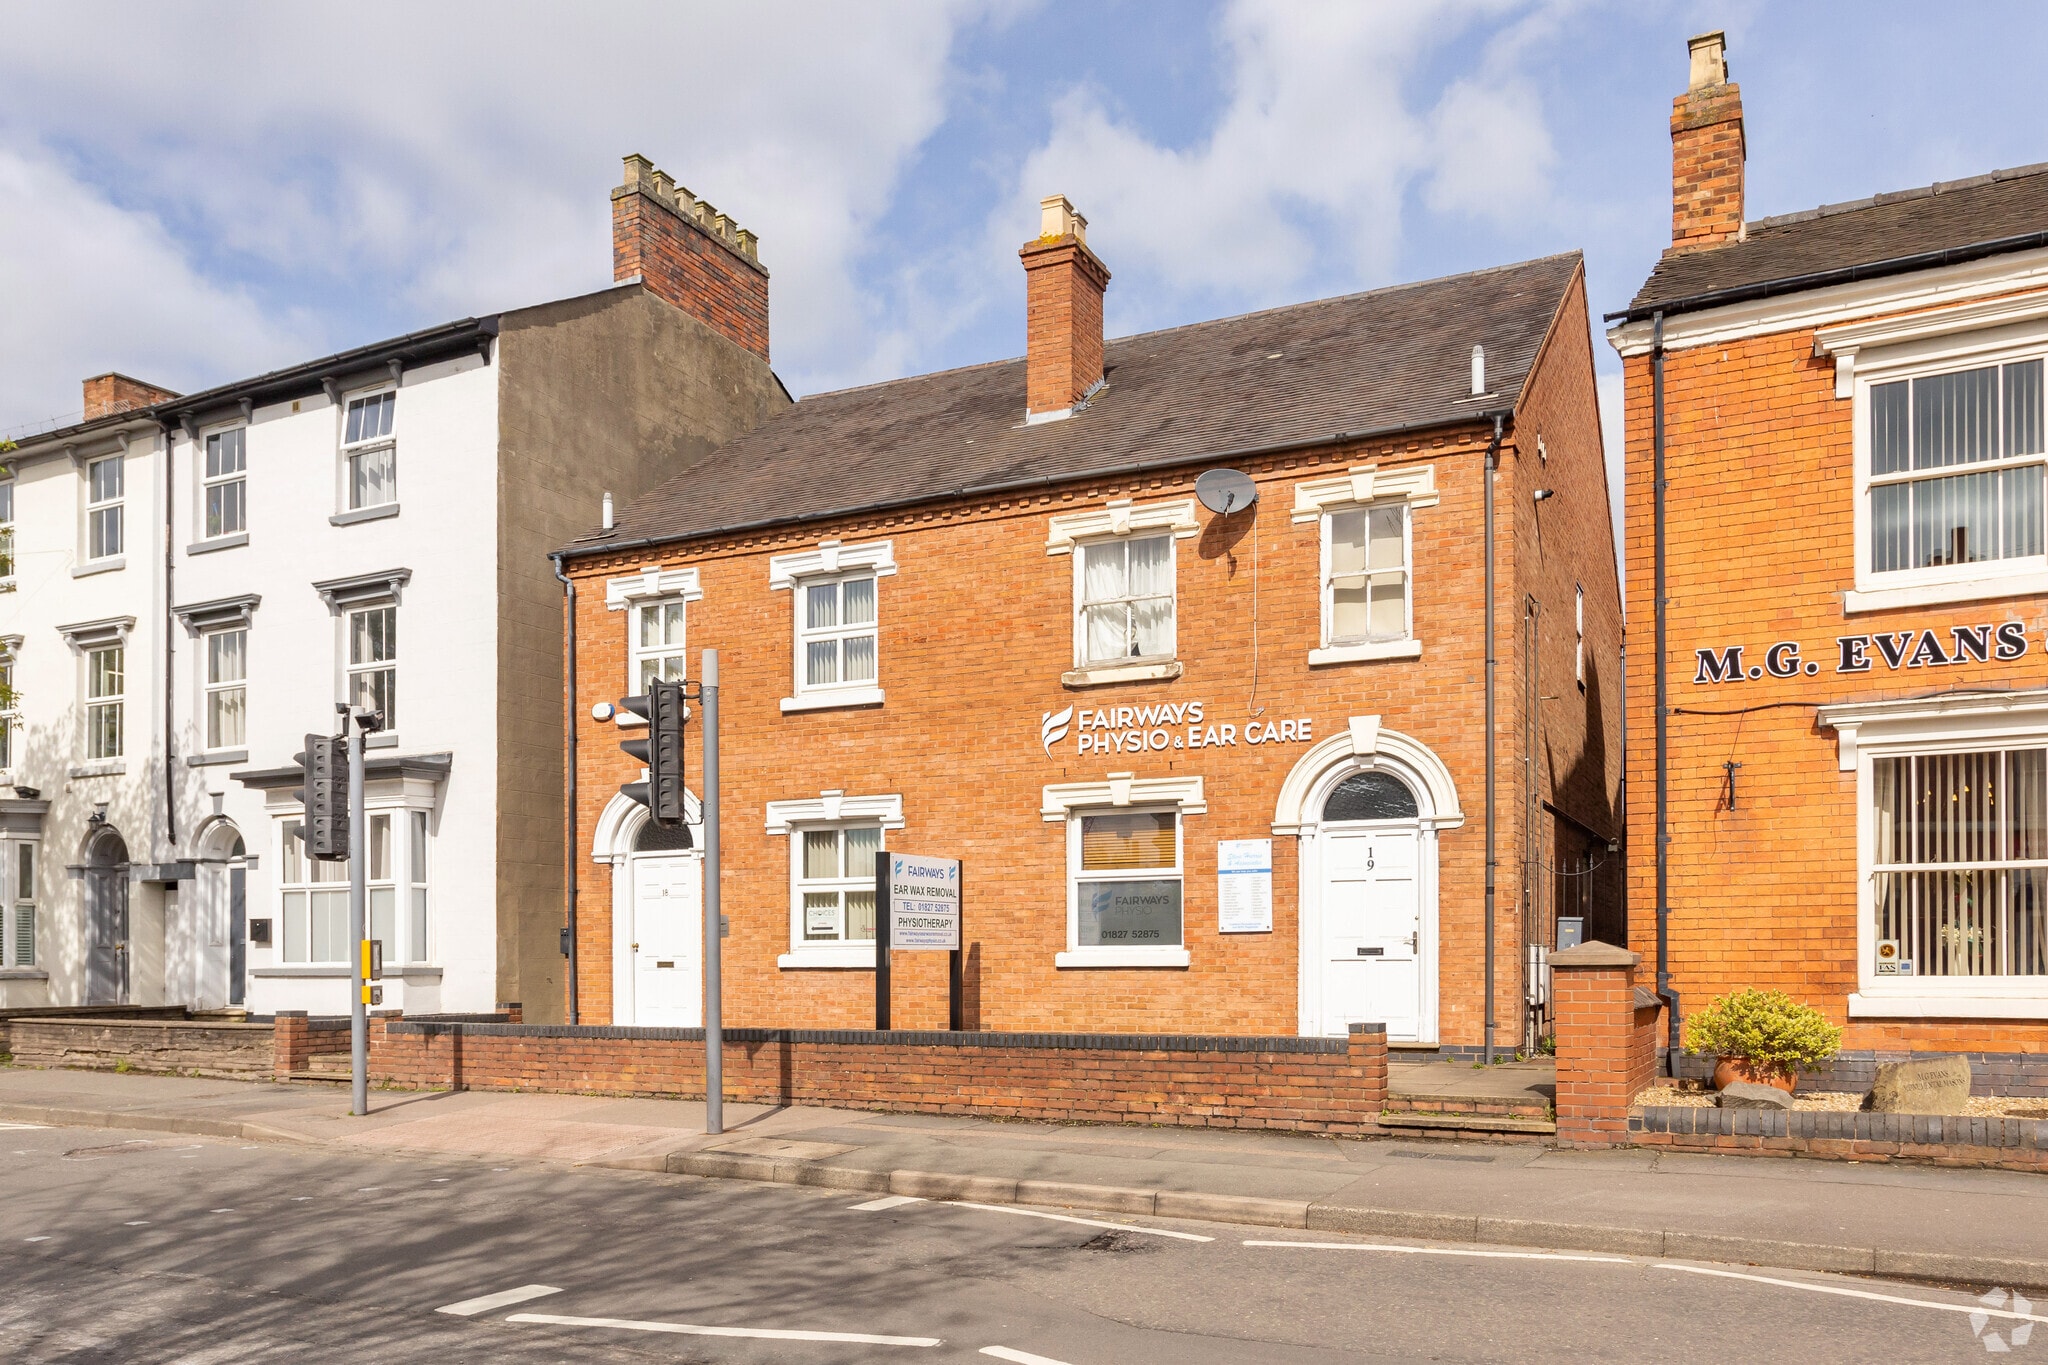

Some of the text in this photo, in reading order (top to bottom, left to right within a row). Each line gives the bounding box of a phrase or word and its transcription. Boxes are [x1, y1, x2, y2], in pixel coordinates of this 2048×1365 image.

[1693, 622, 2028, 684] M.G. EVANS
[1078, 701, 1204, 731] FAIRWAYS
[1078, 718, 1312, 755] PHYSIO & EAR CARE
[908, 866, 944, 879] FAIRWAYS
[894, 884, 957, 898] EAR WAX REMOVAL
[1115, 895, 1169, 906] FAIRWAYS
[918, 902, 933, 912] 01827
[934, 903, 950, 912] 52875
[1115, 905, 1153, 916] PHYSIO
[898, 917, 953, 928] PHYSIOTHERAPY
[1101, 929, 1160, 939] 01827 52875
